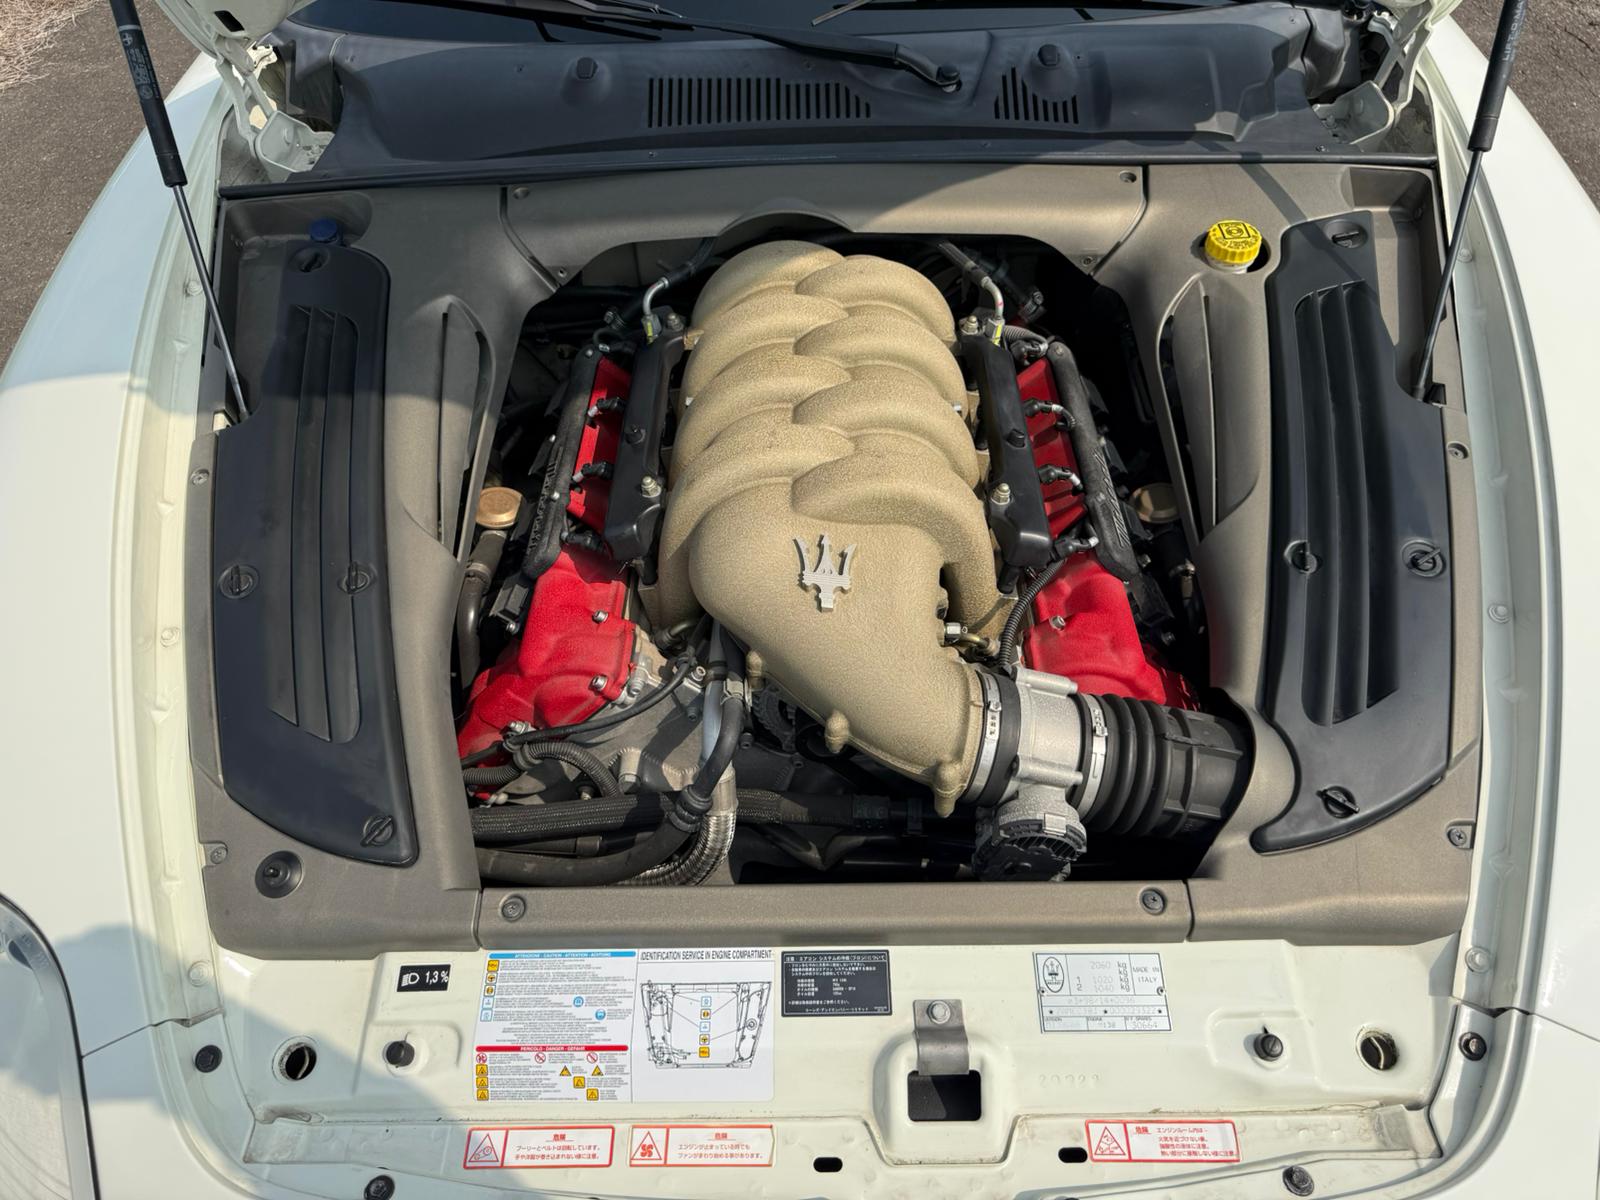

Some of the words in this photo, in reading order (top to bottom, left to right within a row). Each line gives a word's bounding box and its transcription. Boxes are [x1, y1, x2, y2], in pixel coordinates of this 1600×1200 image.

[1502, 0, 1525, 60] LIFT-O-MA
[640, 951, 681, 960] IDENTIFICATION
[682, 951, 704, 960] SERVICE
[705, 951, 711, 959] IN
[712, 950, 731, 959] ENGINE
[732, 950, 772, 959] COMPARTMENT
[425, 970, 439, 985] 1,3
[440, 970, 449, 983] %
